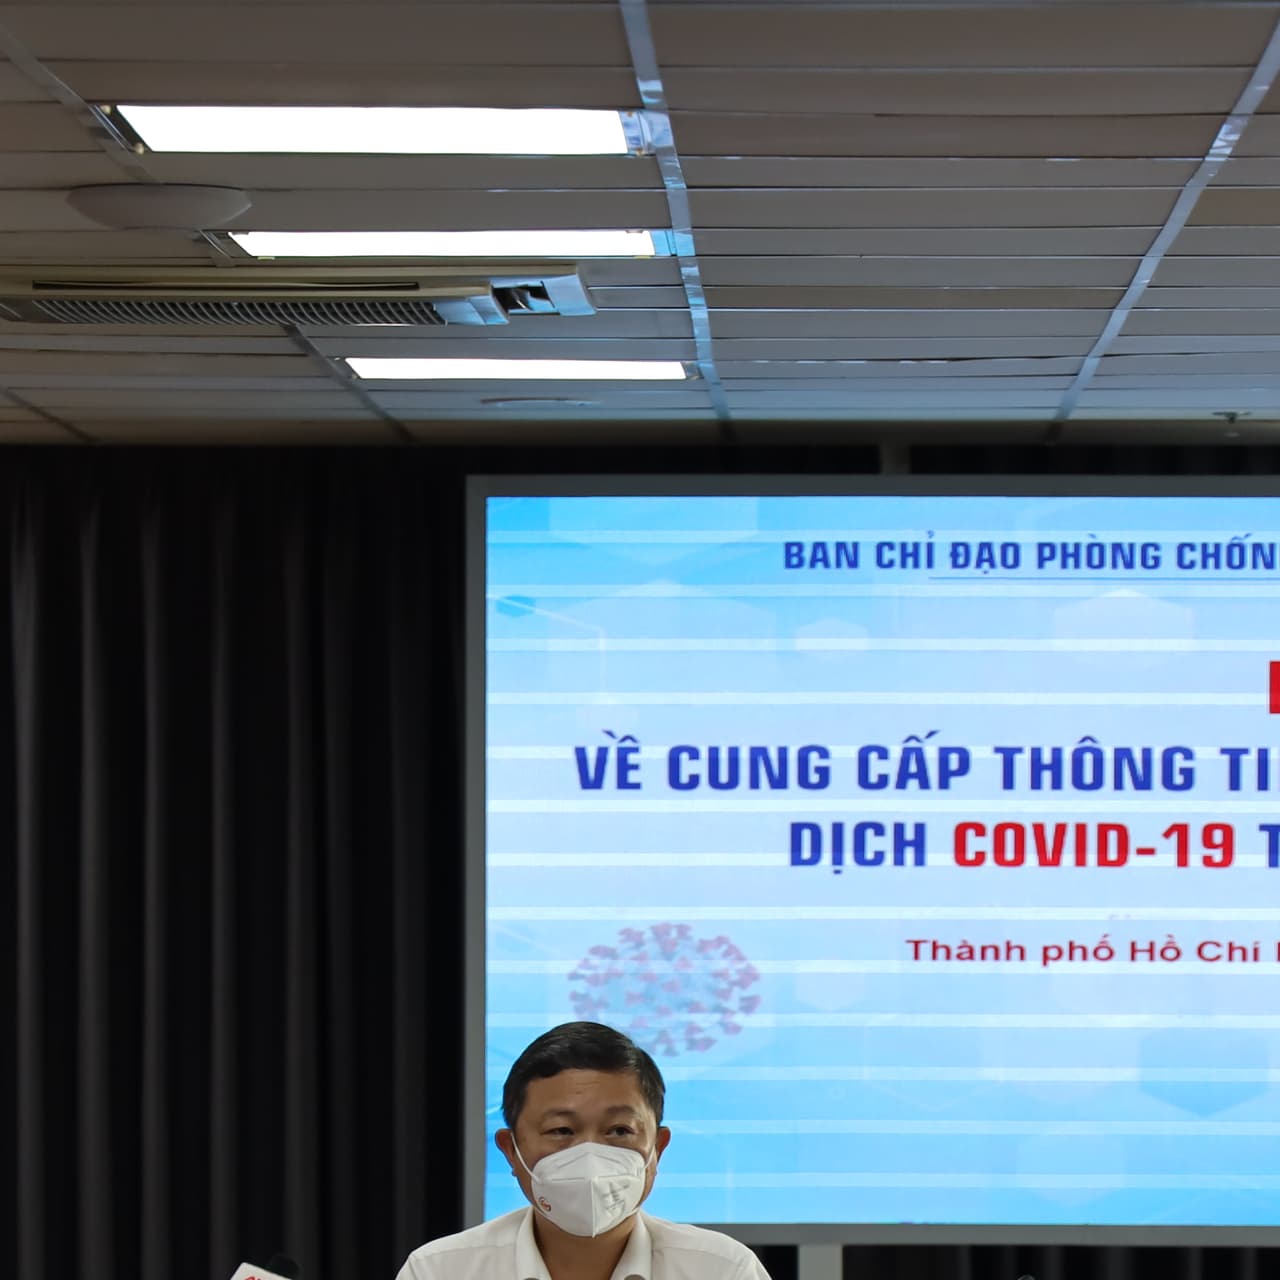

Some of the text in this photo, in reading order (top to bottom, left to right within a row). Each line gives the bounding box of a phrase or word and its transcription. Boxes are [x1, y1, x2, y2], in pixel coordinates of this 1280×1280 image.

[784, 541, 860, 569] BAN
[876, 530, 935, 569] CHỈ
[949, 542, 1020, 574] ĐẠO
[1037, 533, 1161, 570] PHÒNG
[574, 730, 642, 790] VỀ
[668, 745, 831, 791] CUNG
[857, 730, 971, 791] CẤP
[994, 735, 1195, 792] THÔNG
[790, 821, 927, 875] DỊCH
[953, 821, 1235, 869] COVID-19
[906, 938, 1026, 961] Thành
[1042, 934, 1115, 967] phố
[1130, 934, 1182, 962] Hồ
[1196, 940, 1260, 962] Chí
